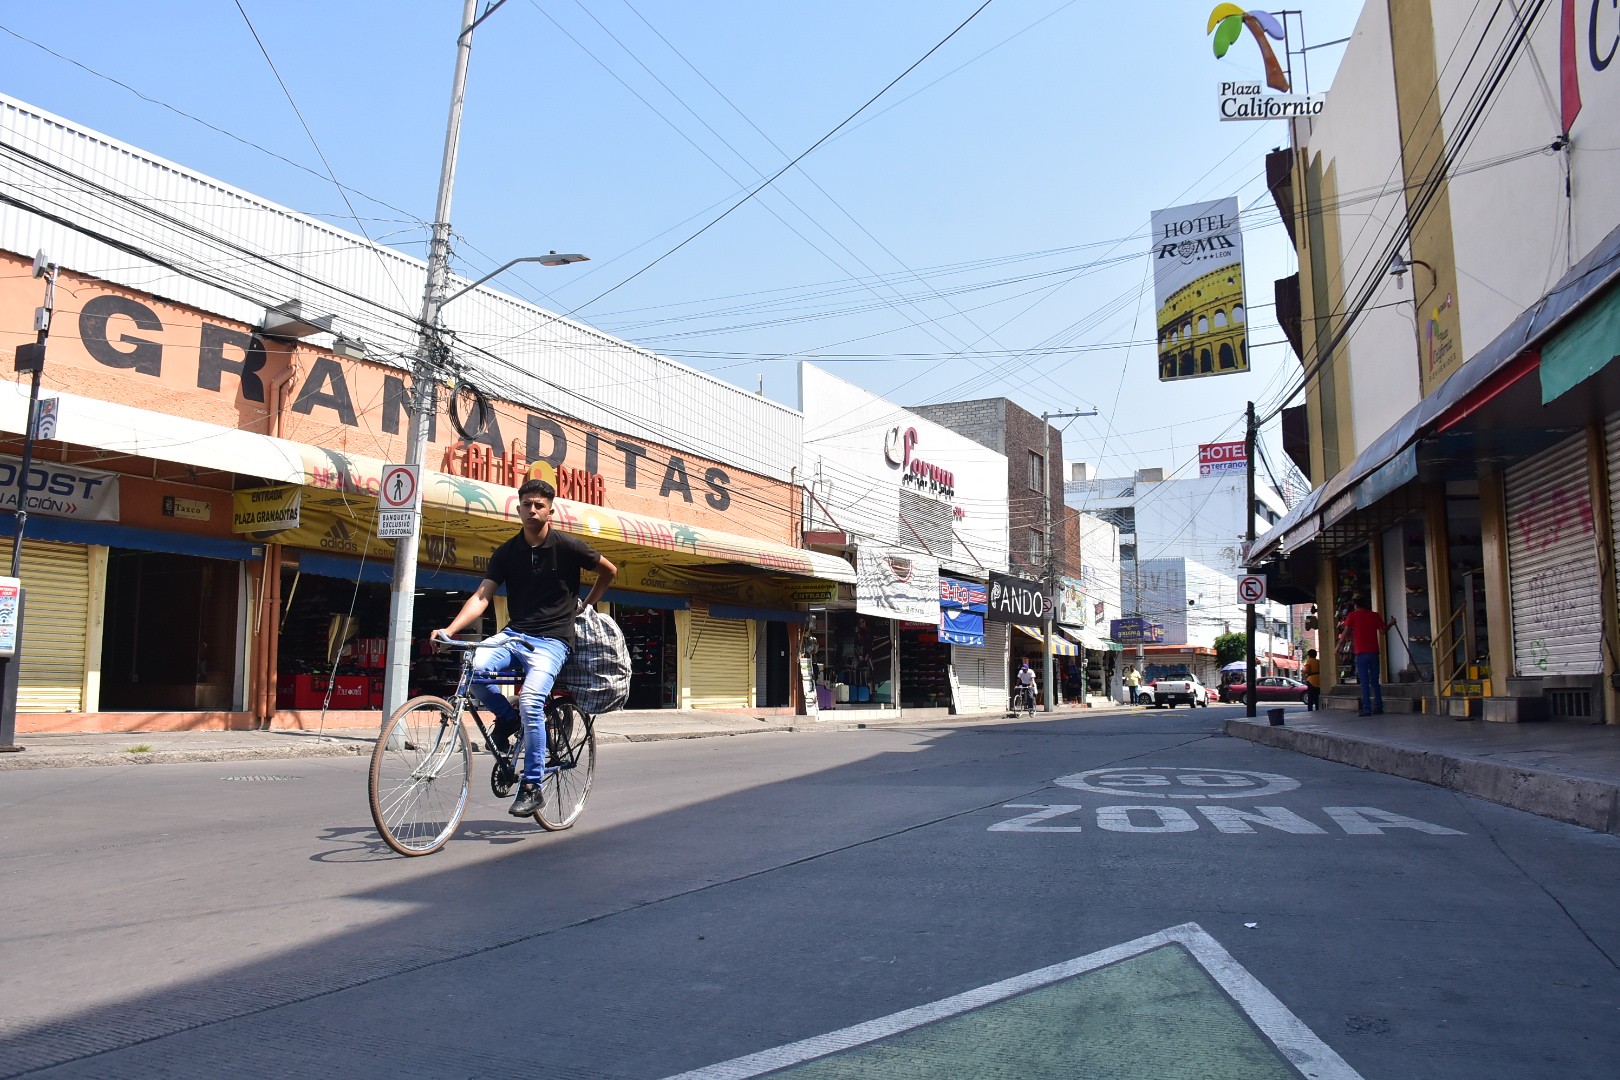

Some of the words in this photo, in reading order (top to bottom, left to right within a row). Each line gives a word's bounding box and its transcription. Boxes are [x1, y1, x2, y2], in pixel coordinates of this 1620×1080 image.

[1221, 82, 1261, 96] Plaza
[1221, 96, 1324, 118] California
[1164, 214, 1231, 239] HOTEL
[1200, 445, 1247, 460] HOTEL
[1211, 461, 1248, 470] Terranov
[251, 489, 283, 502] ENTRADA
[175, 503, 201, 514] Taxco
[234, 512, 255, 525] PLAZA
[382, 513, 411, 521] BANQUETA
[382, 521, 411, 529] EXCLUSIVO
[320, 538, 358, 552] adidas
[986, 803, 1469, 836] ZONA
